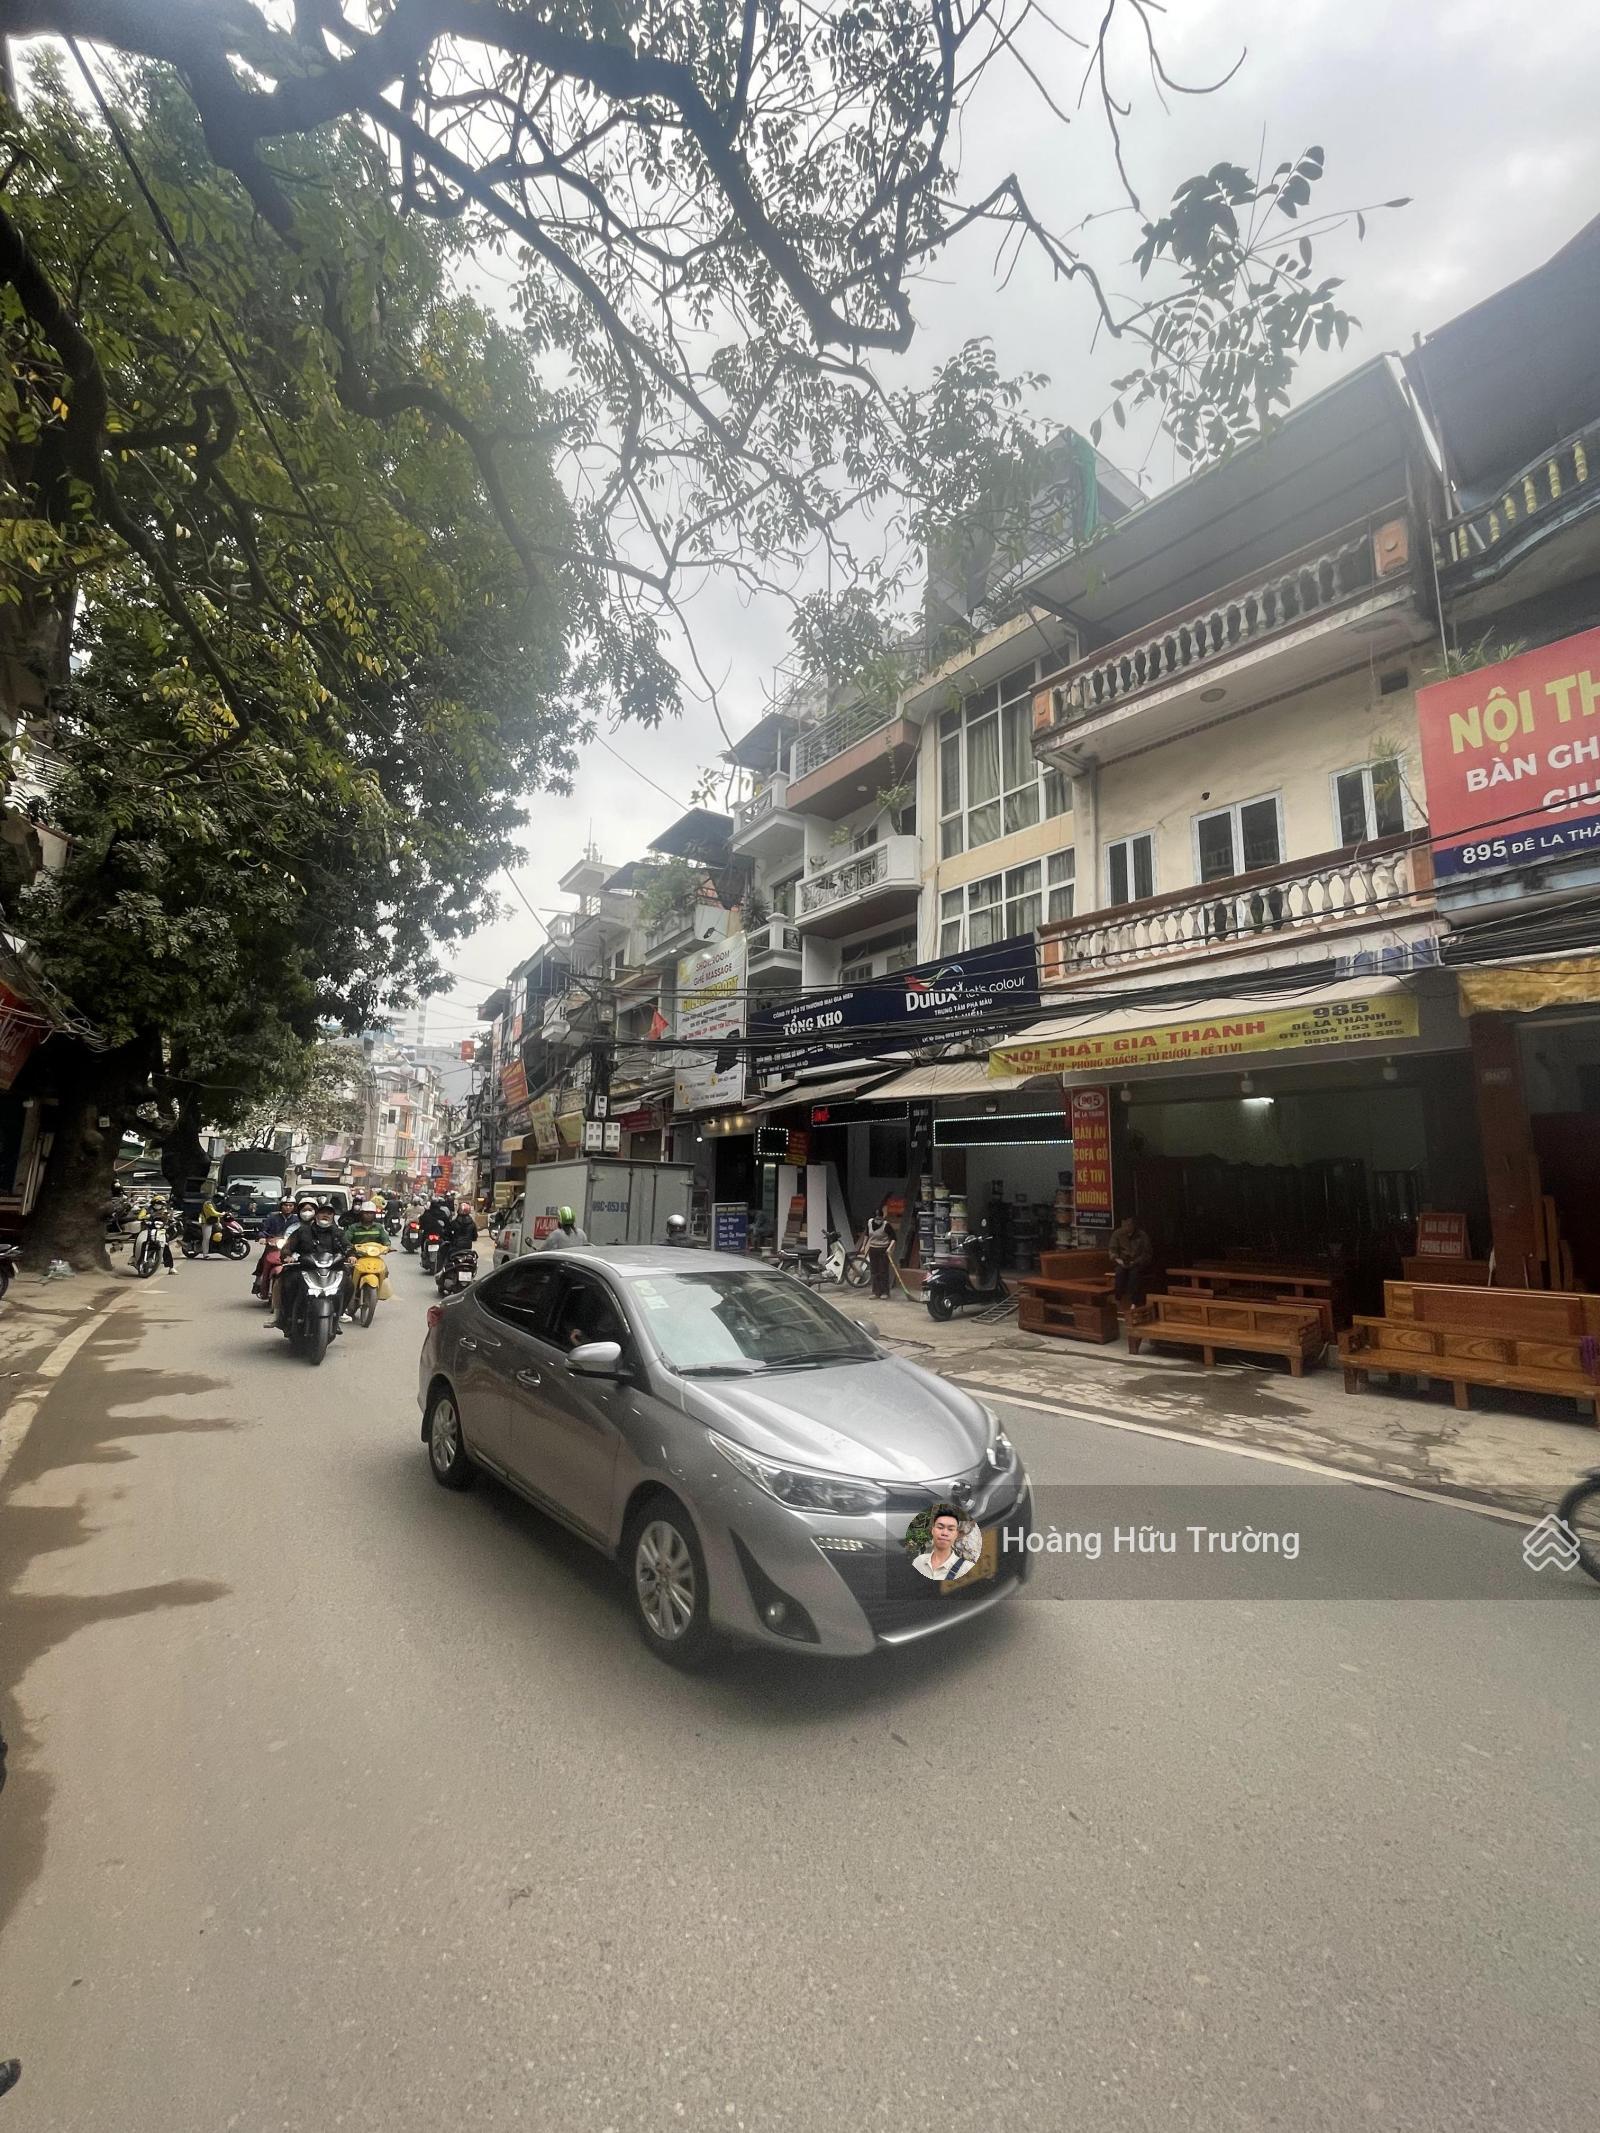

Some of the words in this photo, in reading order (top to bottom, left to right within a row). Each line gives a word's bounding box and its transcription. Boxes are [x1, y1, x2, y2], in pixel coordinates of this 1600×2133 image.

[1449, 686, 1535, 754] NỘI
[1466, 753, 1537, 793] BÀN
[1462, 839, 1507, 864] 895
[1511, 837, 1535, 855] ĐÊ
[1540, 833, 1564, 848] LA
[705, 963, 732, 980] MASSAGE
[905, 985, 958, 1012] Dulux
[989, 976, 1026, 993] colour
[934, 1006, 953, 1016] TRUNG
[953, 1003, 965, 1013] TÂM
[966, 1000, 978, 1009] PHA
[1312, 1001, 1370, 1019] 985
[783, 1014, 814, 1036] TỔNG
[816, 1010, 843, 1028] KHO
[1315, 1018, 1332, 1028] LA
[1113, 1035, 1157, 1051] GIA
[1073, 1147, 1094, 1161] SOFA
